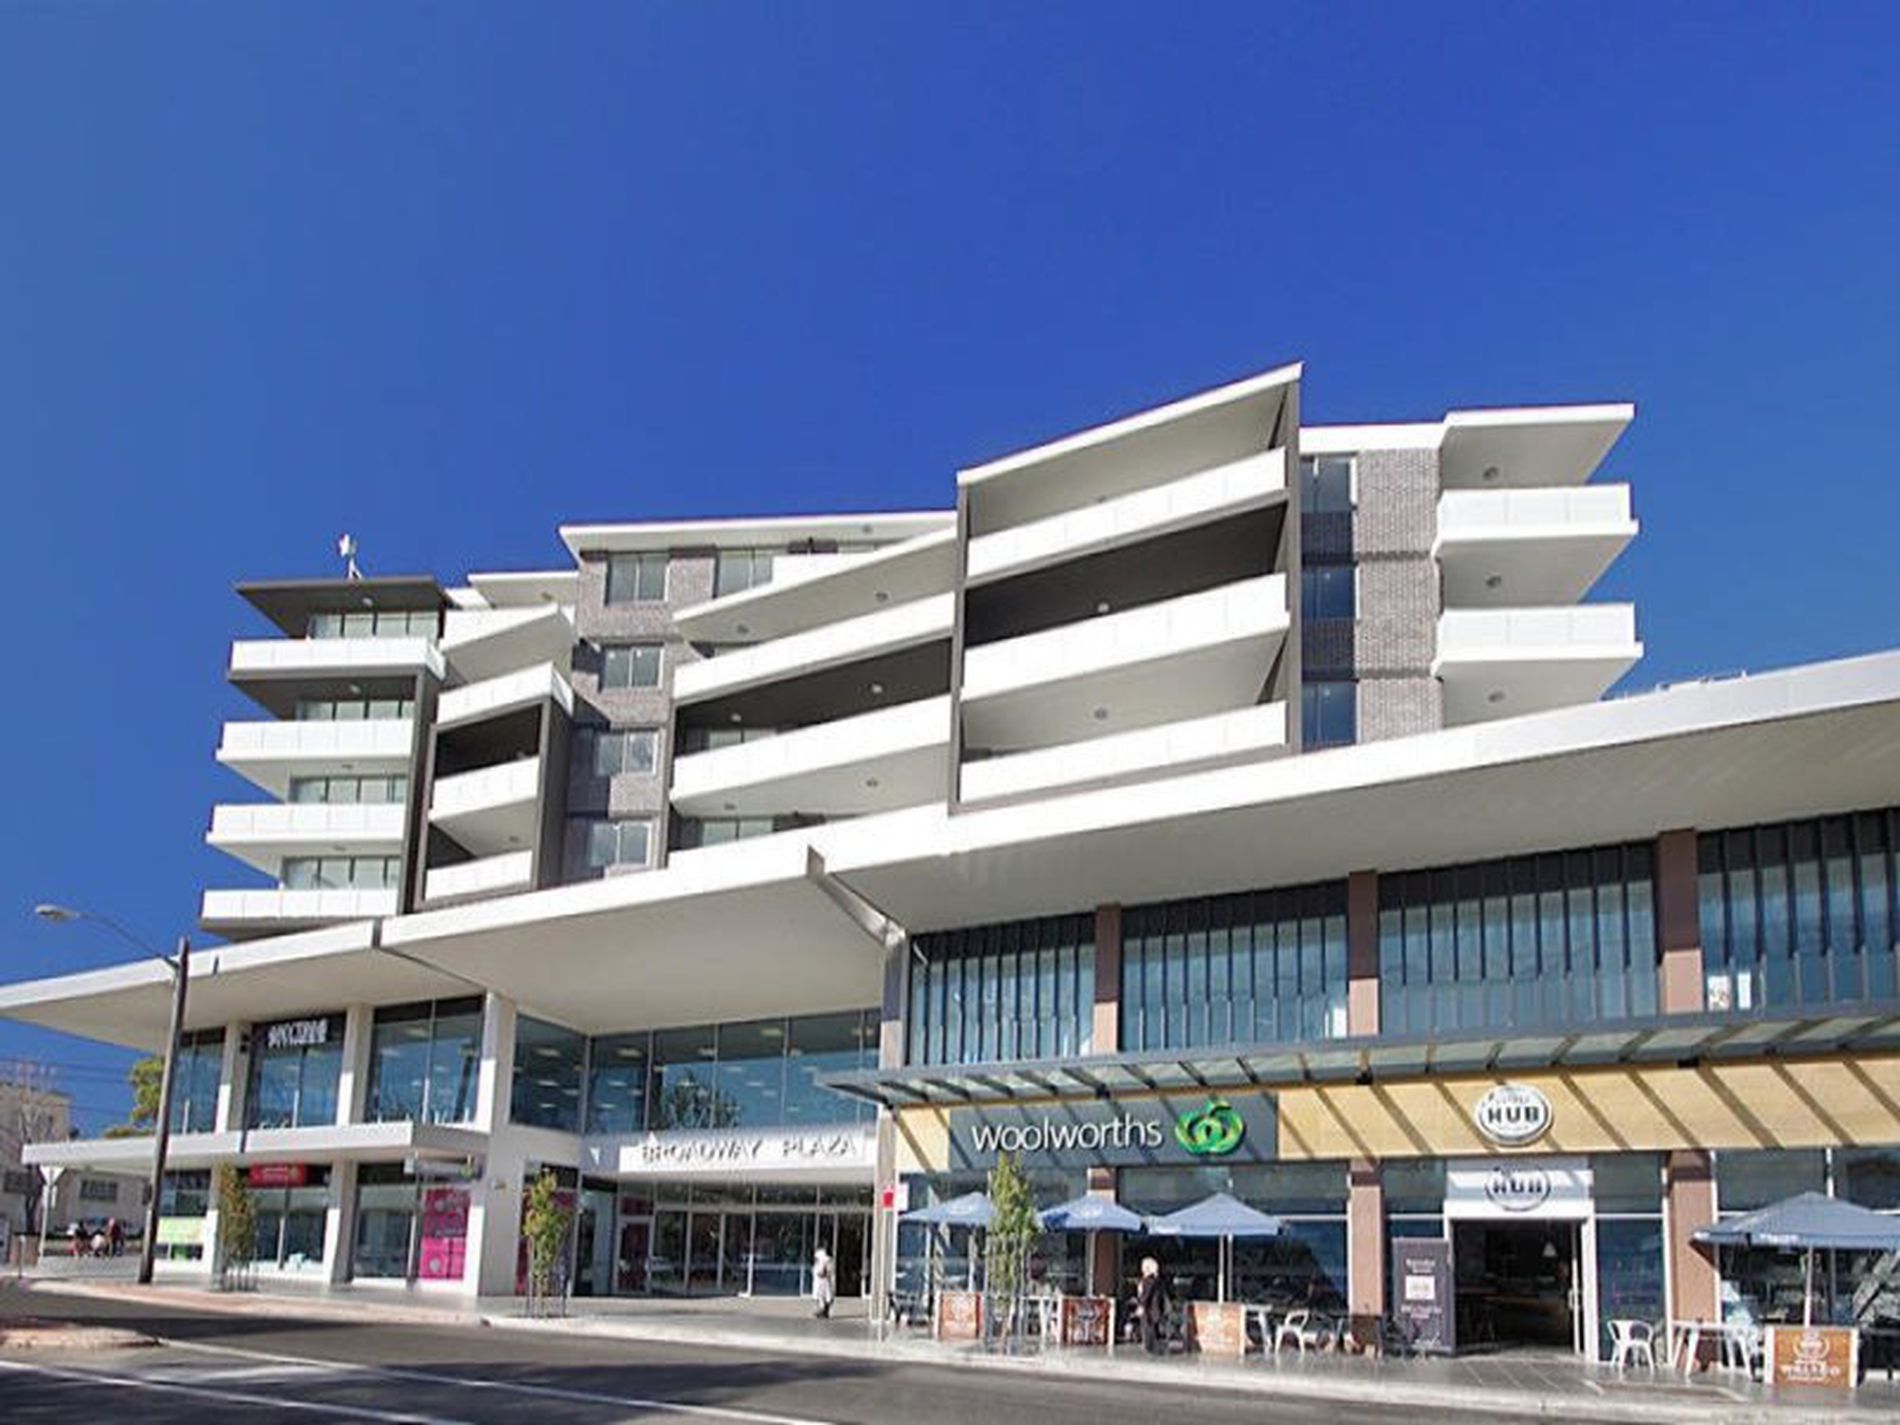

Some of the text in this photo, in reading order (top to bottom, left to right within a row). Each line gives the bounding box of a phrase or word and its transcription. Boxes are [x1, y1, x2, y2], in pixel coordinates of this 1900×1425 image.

[1488, 1106, 1538, 1124] HUB
[973, 1112, 1163, 1151] woolworths
[641, 1132, 858, 1163] BROADWAY PLAZA
